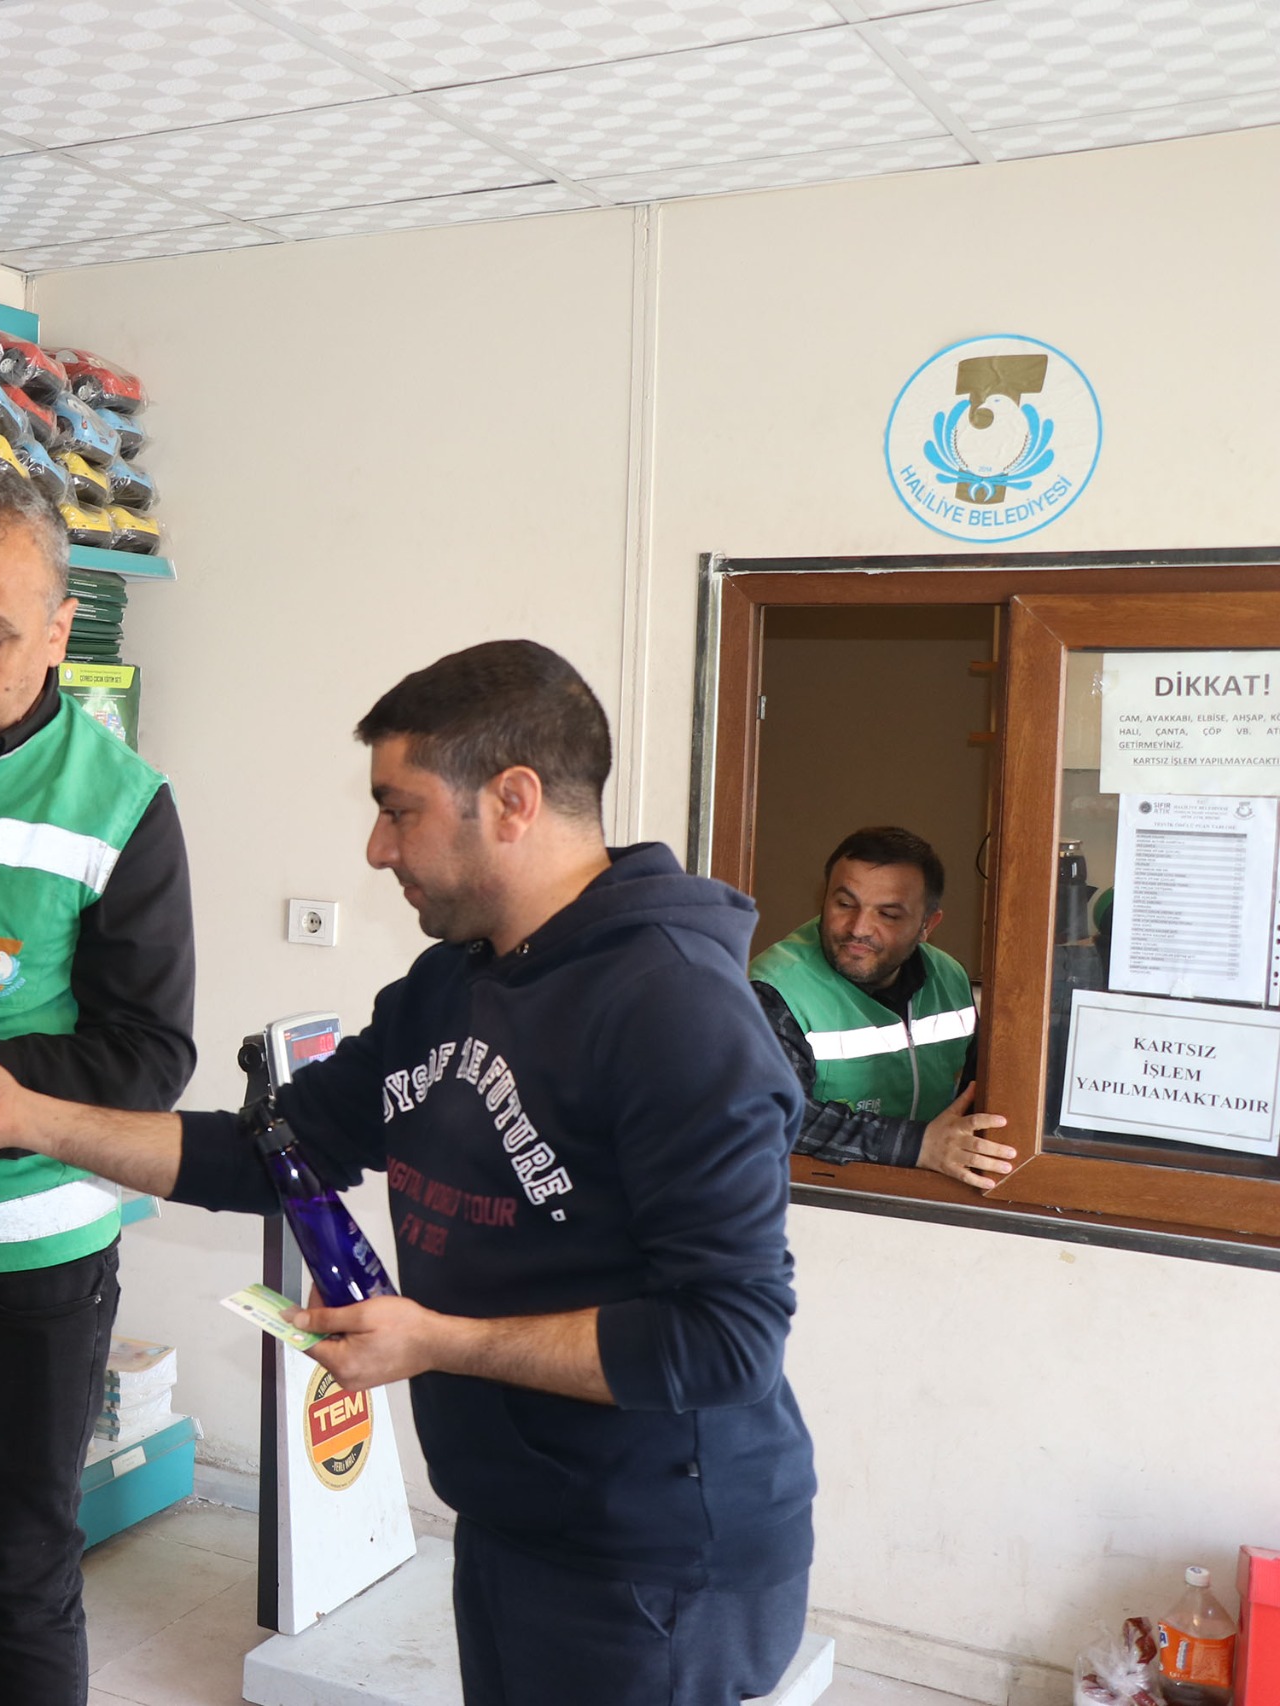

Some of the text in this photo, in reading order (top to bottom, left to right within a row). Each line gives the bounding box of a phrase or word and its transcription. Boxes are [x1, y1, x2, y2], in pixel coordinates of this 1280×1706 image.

[900, 465, 1073, 526] HALİLİYE BELEDİYESİ
[1155, 671, 1271, 697] DİKKAT!
[1120, 714, 1143, 723] CAM,
[1146, 714, 1193, 723] AYAKKABI,
[1197, 713, 1228, 723] ELBİSE,
[1232, 713, 1266, 723] AHŞAP,
[1120, 728, 1141, 736] HALI,
[1156, 727, 1188, 737] ÇANTA,
[1203, 727, 1221, 737] ÇÖP
[1119, 740, 1184, 750] GETİRMEYİNİZ.
[1133, 757, 1169, 765] KARTSIZ
[1171, 756, 1197, 766] İŞLEM
[1134, 1037, 1217, 1059] KARTSIZ
[1143, 1060, 1202, 1082] İŞLEM
[1076, 1077, 1270, 1114] YAPILMAMAKTADIR
[313, 1390, 364, 1432] TEM
